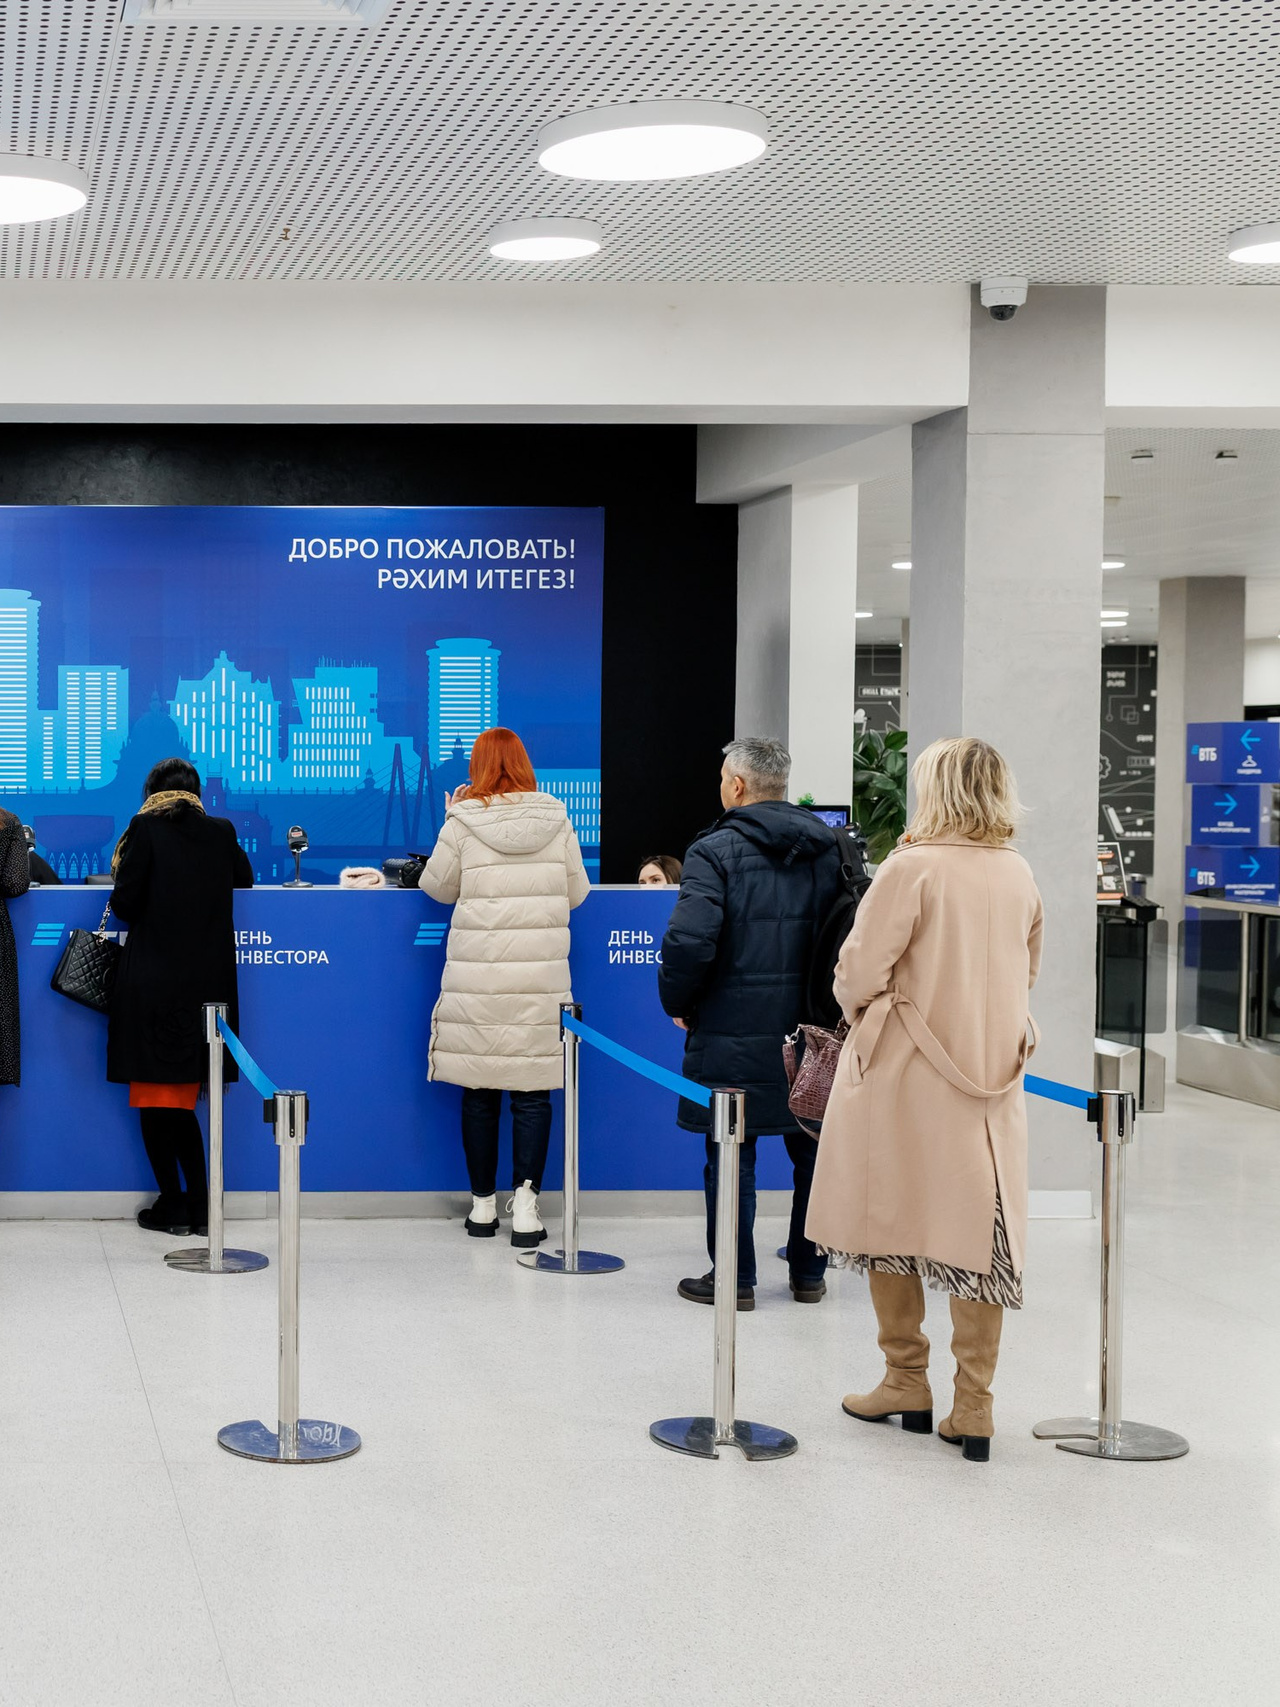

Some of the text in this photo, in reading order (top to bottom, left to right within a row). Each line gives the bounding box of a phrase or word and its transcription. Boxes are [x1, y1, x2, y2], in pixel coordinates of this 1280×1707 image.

[288, 538, 575, 562] ДОБРО ПОЖАЛОВАТЬ!
[377, 568, 575, 589] РӘХИМ ИТЕГЕЗ!
[1199, 747, 1217, 761] ВТБ
[1197, 871, 1216, 886] ВТБ
[608, 930, 654, 947] ДЕНЬ
[609, 950, 663, 964] ИНВЕС
